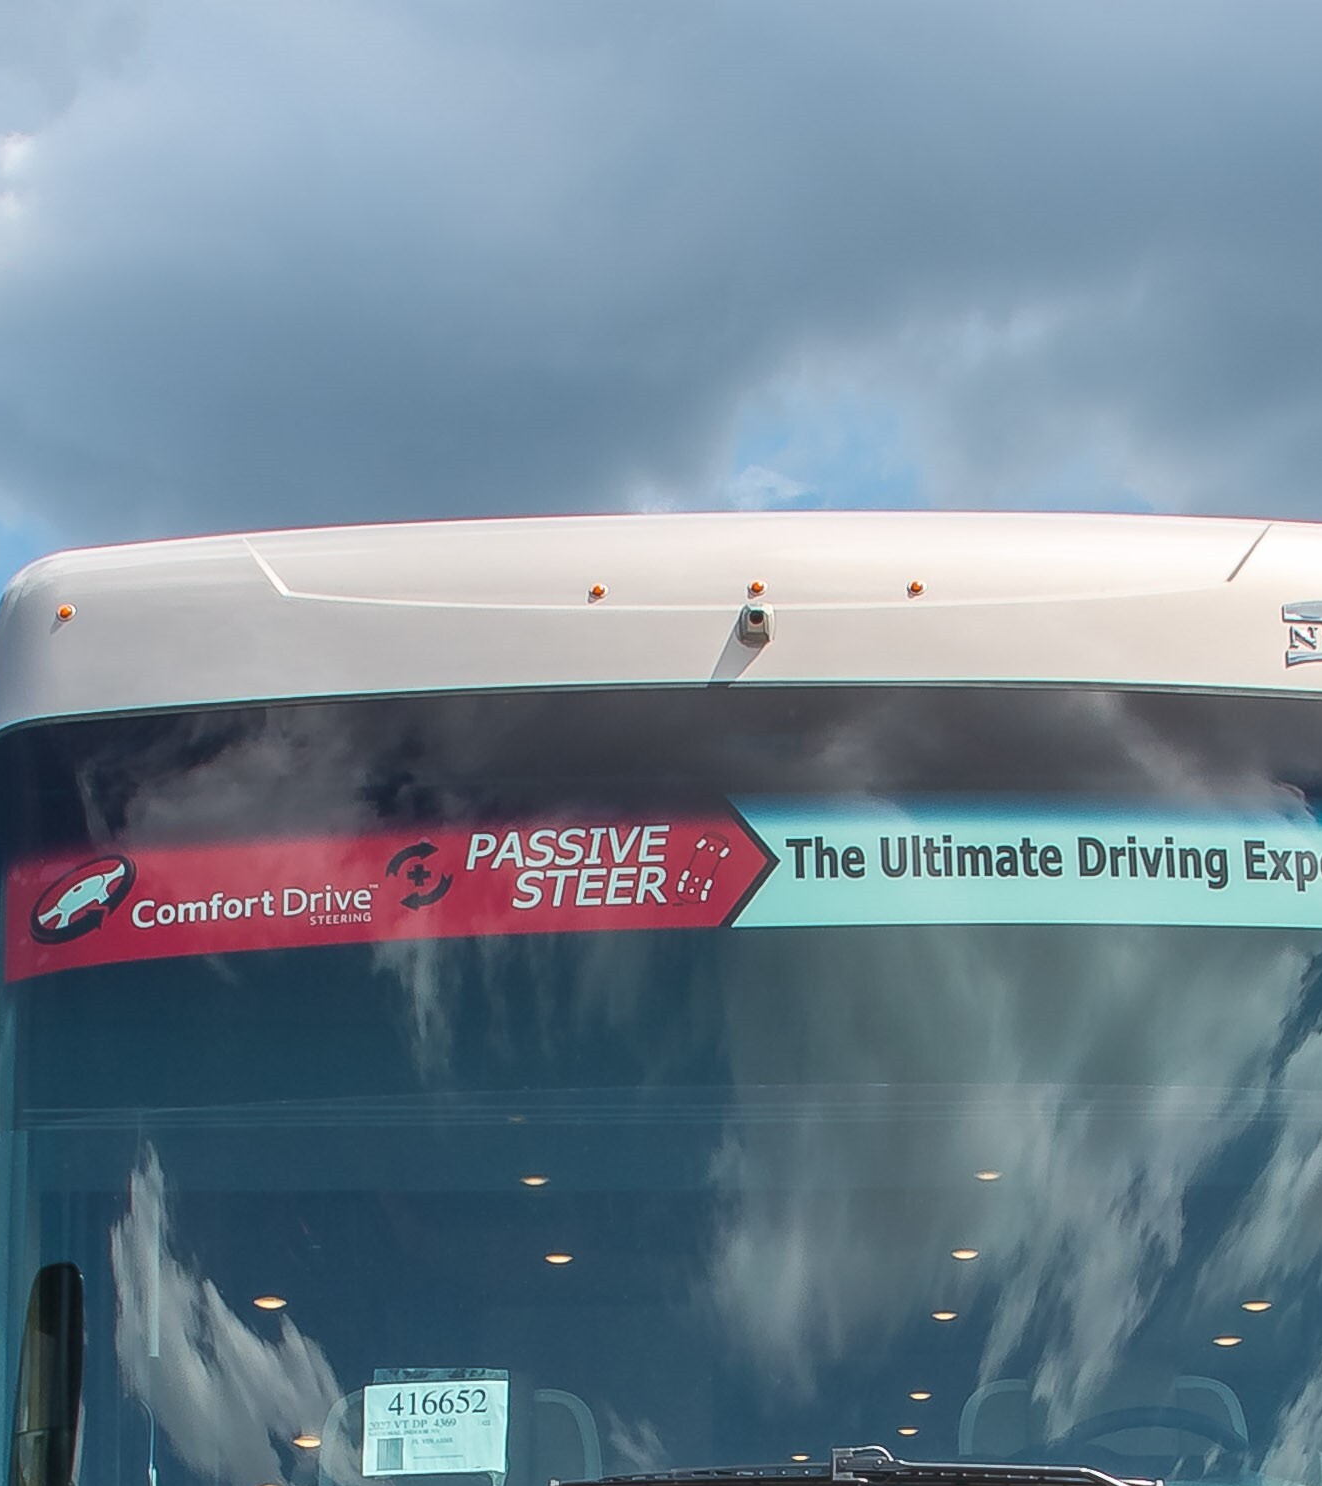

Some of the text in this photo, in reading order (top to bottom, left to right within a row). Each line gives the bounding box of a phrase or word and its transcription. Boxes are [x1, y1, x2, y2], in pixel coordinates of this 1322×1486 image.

[466, 825, 670, 870] PASSIVE
[785, 836, 866, 879] The
[879, 834, 1064, 879] Ultimate
[1078, 835, 1229, 890] Driving
[512, 866, 668, 909] STEER
[131, 890, 275, 929] Comfort
[310, 912, 373, 926] STEERING
[387, 1388, 488, 1416] 416652
[394, 1419, 409, 1429] VT
[412, 1418, 428, 1428] DP
[433, 1417, 457, 1428] 4369
